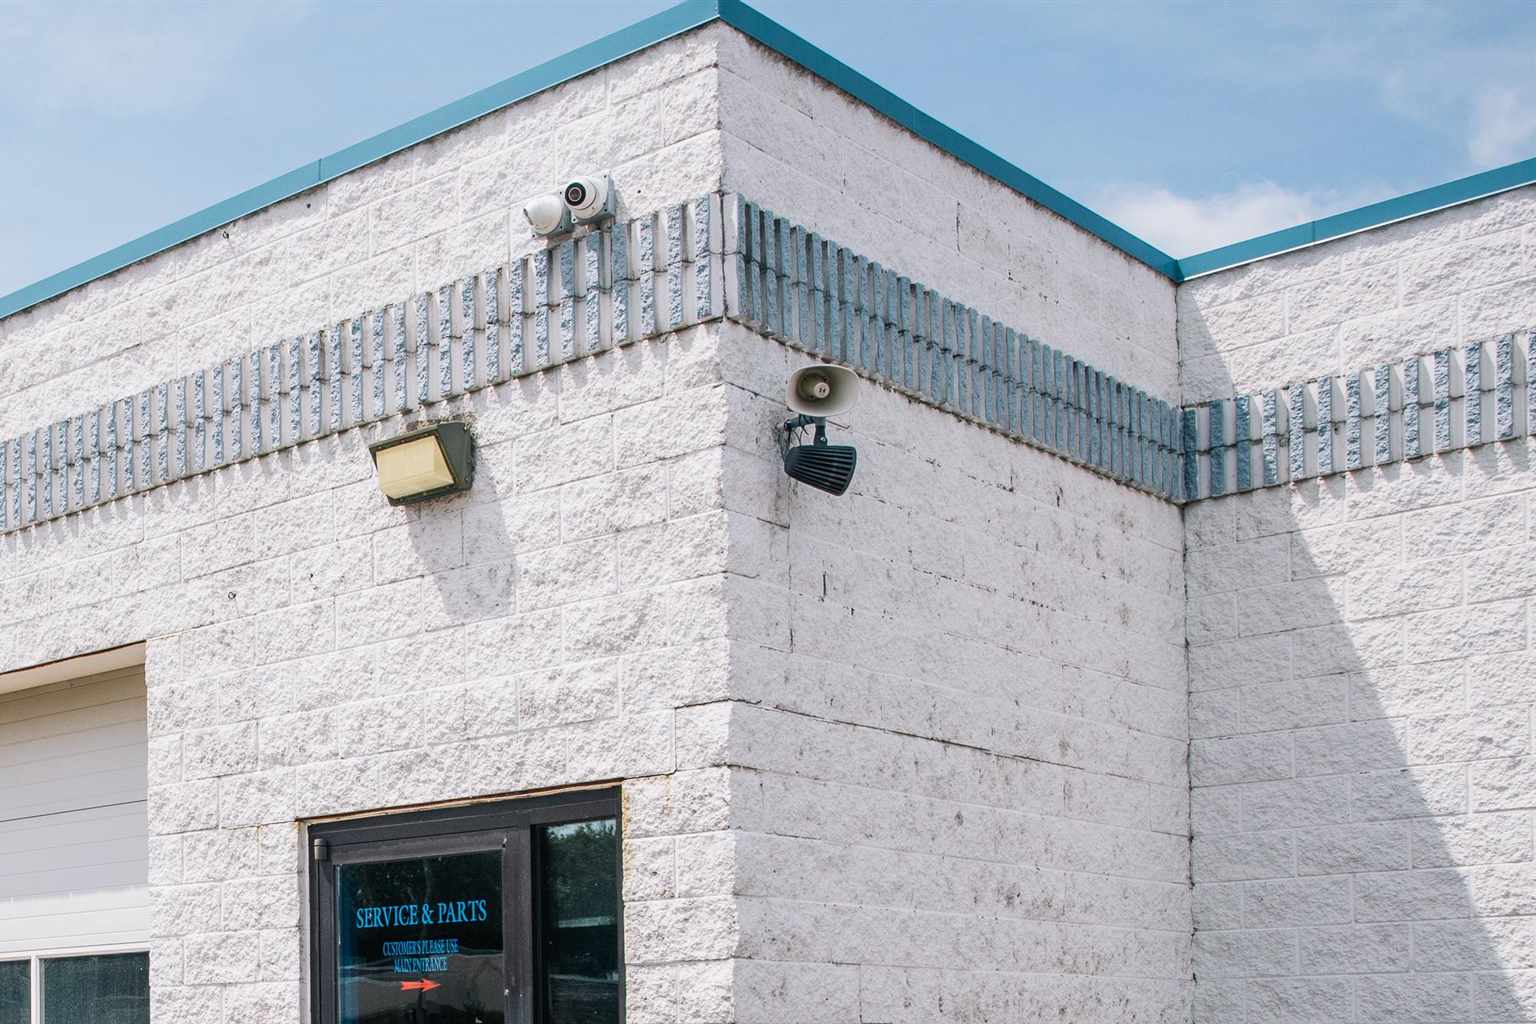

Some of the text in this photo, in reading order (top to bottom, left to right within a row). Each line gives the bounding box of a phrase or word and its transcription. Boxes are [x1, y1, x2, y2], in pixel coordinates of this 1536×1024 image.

[356, 899, 488, 929] SERVICE & PARTS
[421, 939, 446, 955] PLEASE
[447, 938, 459, 954] USE
[394, 956, 448, 974] MAIN ENTRANCE
